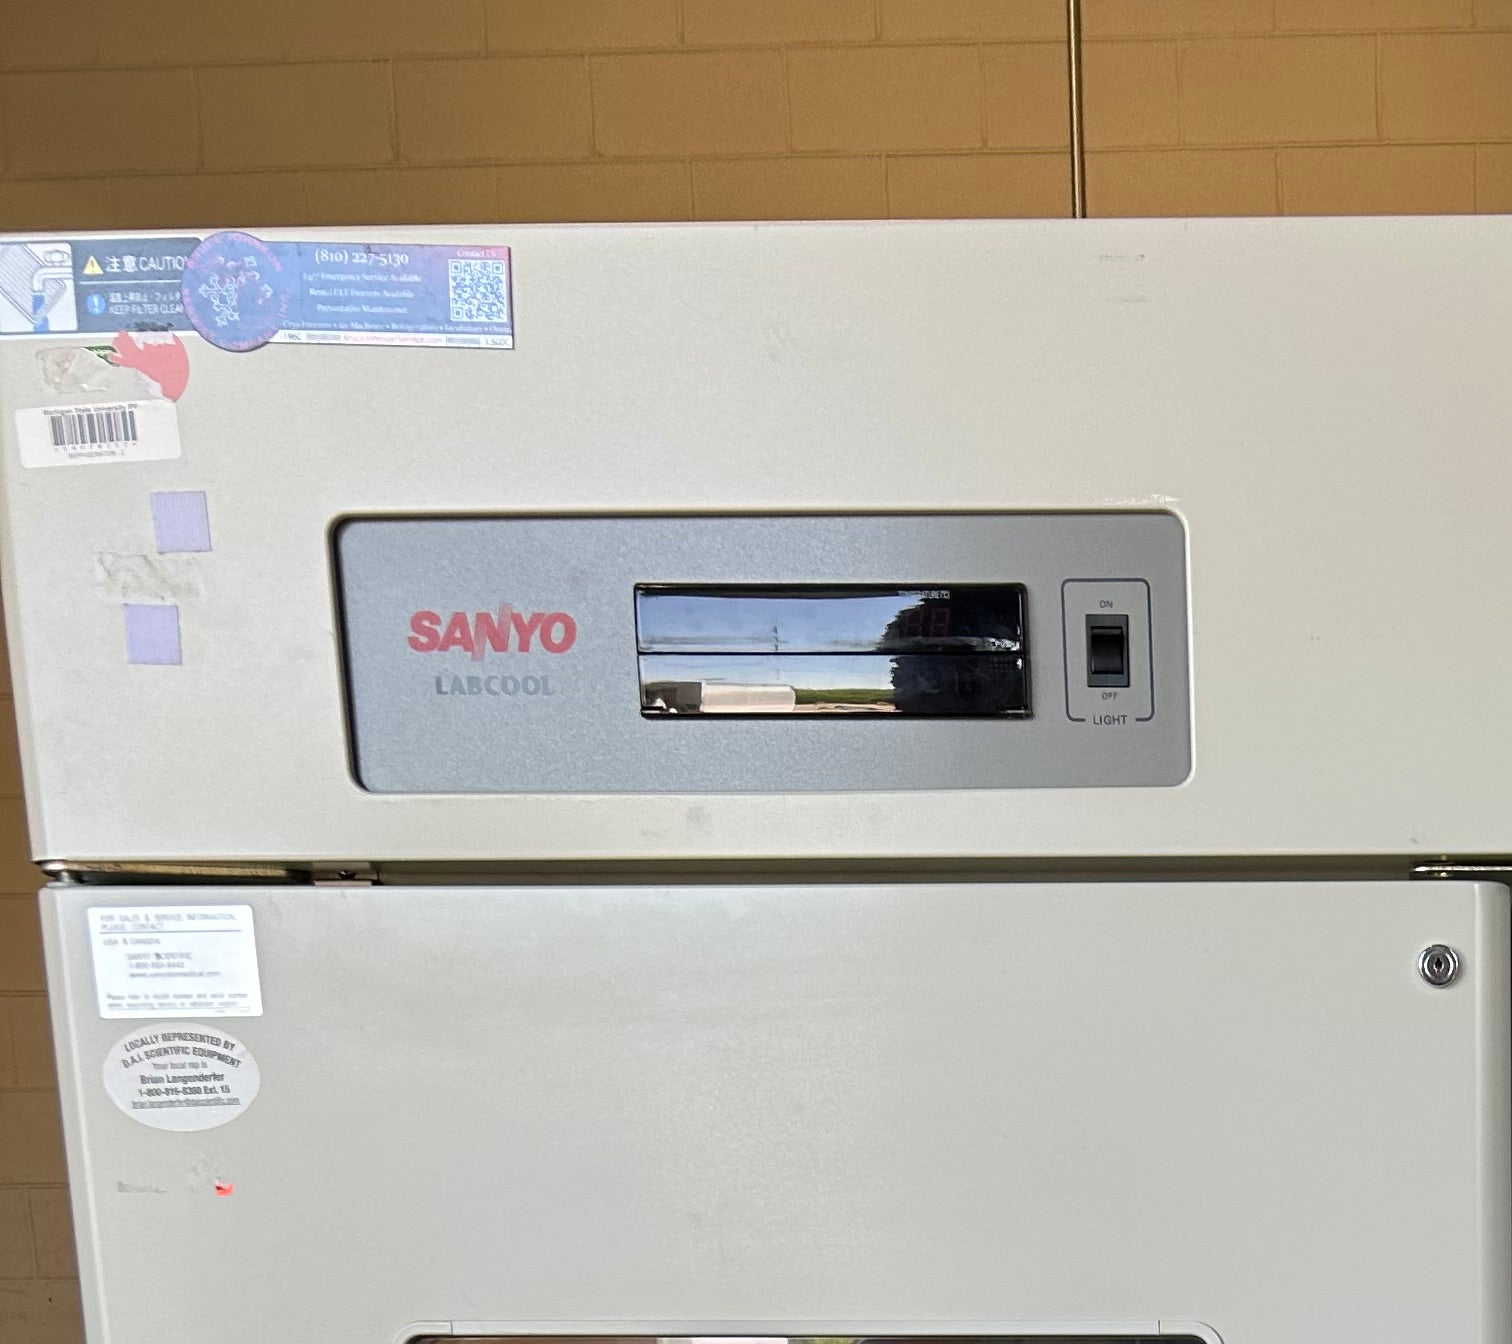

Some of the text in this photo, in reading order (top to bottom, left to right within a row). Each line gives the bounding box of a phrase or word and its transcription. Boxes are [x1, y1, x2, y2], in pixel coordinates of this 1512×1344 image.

[106, 255, 188, 273] 注意 CAUTIO
[315, 249, 409, 267] (810) 227-5130
[1100, 600, 1113, 609] ON
[407, 602, 577, 662] SANYO
[435, 675, 555, 695] LABCOOL
[1101, 692, 1118, 700] OFF
[1092, 715, 1128, 725] LIGHT
[124, 1032, 235, 1052] LOCALLY REPRESENTED BY
[144, 1046, 191, 1060] SCIENTIFIC
[192, 1046, 242, 1068] EQUIPMENT
[140, 1074, 165, 1084] Brian
